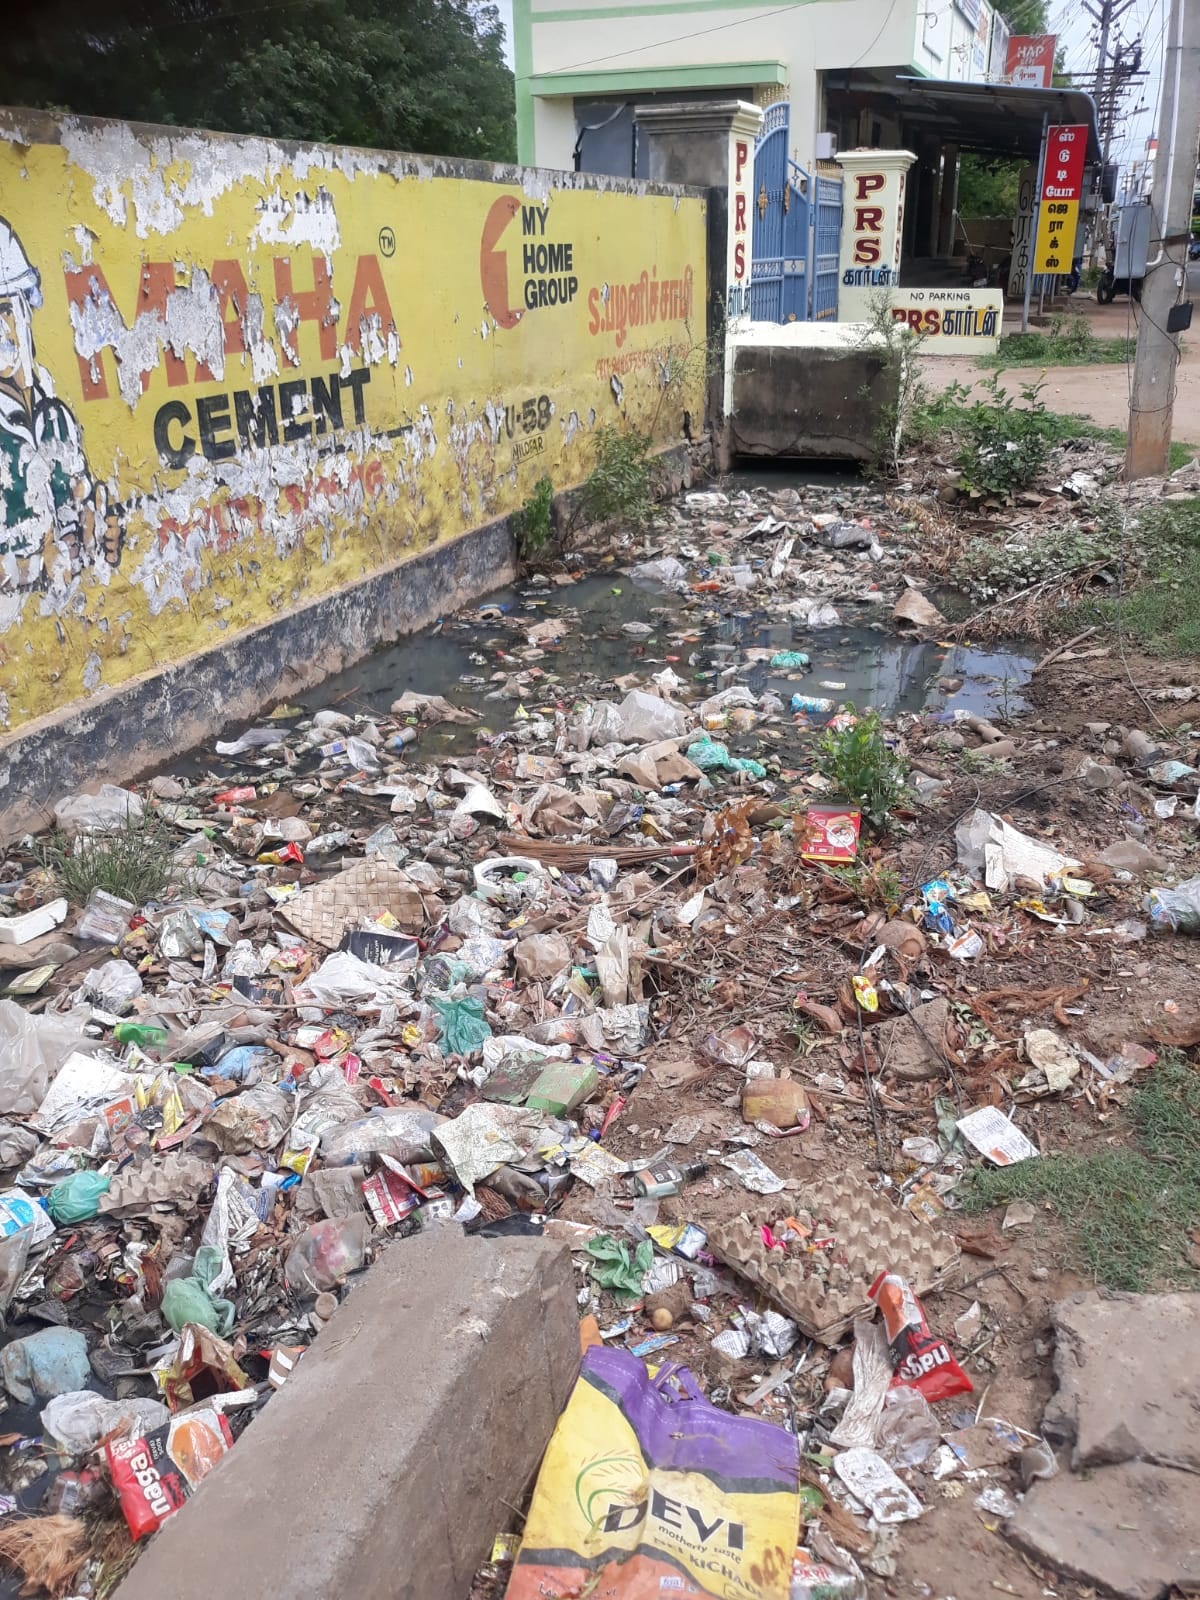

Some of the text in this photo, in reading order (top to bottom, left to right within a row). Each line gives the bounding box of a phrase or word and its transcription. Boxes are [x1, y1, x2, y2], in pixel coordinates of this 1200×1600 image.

[521, 206, 549, 236] MY
[523, 243, 573, 274] HOME
[524, 276, 578, 310] GROUP
[910, 292, 971, 301] NO PARKING
[154, 368, 371, 469] CEMENT
[130, 1452, 171, 1516] naga
[604, 1489, 744, 1550] DEVI
[658, 1525, 708, 1552] motherly
[714, 1546, 742, 1565] taste
